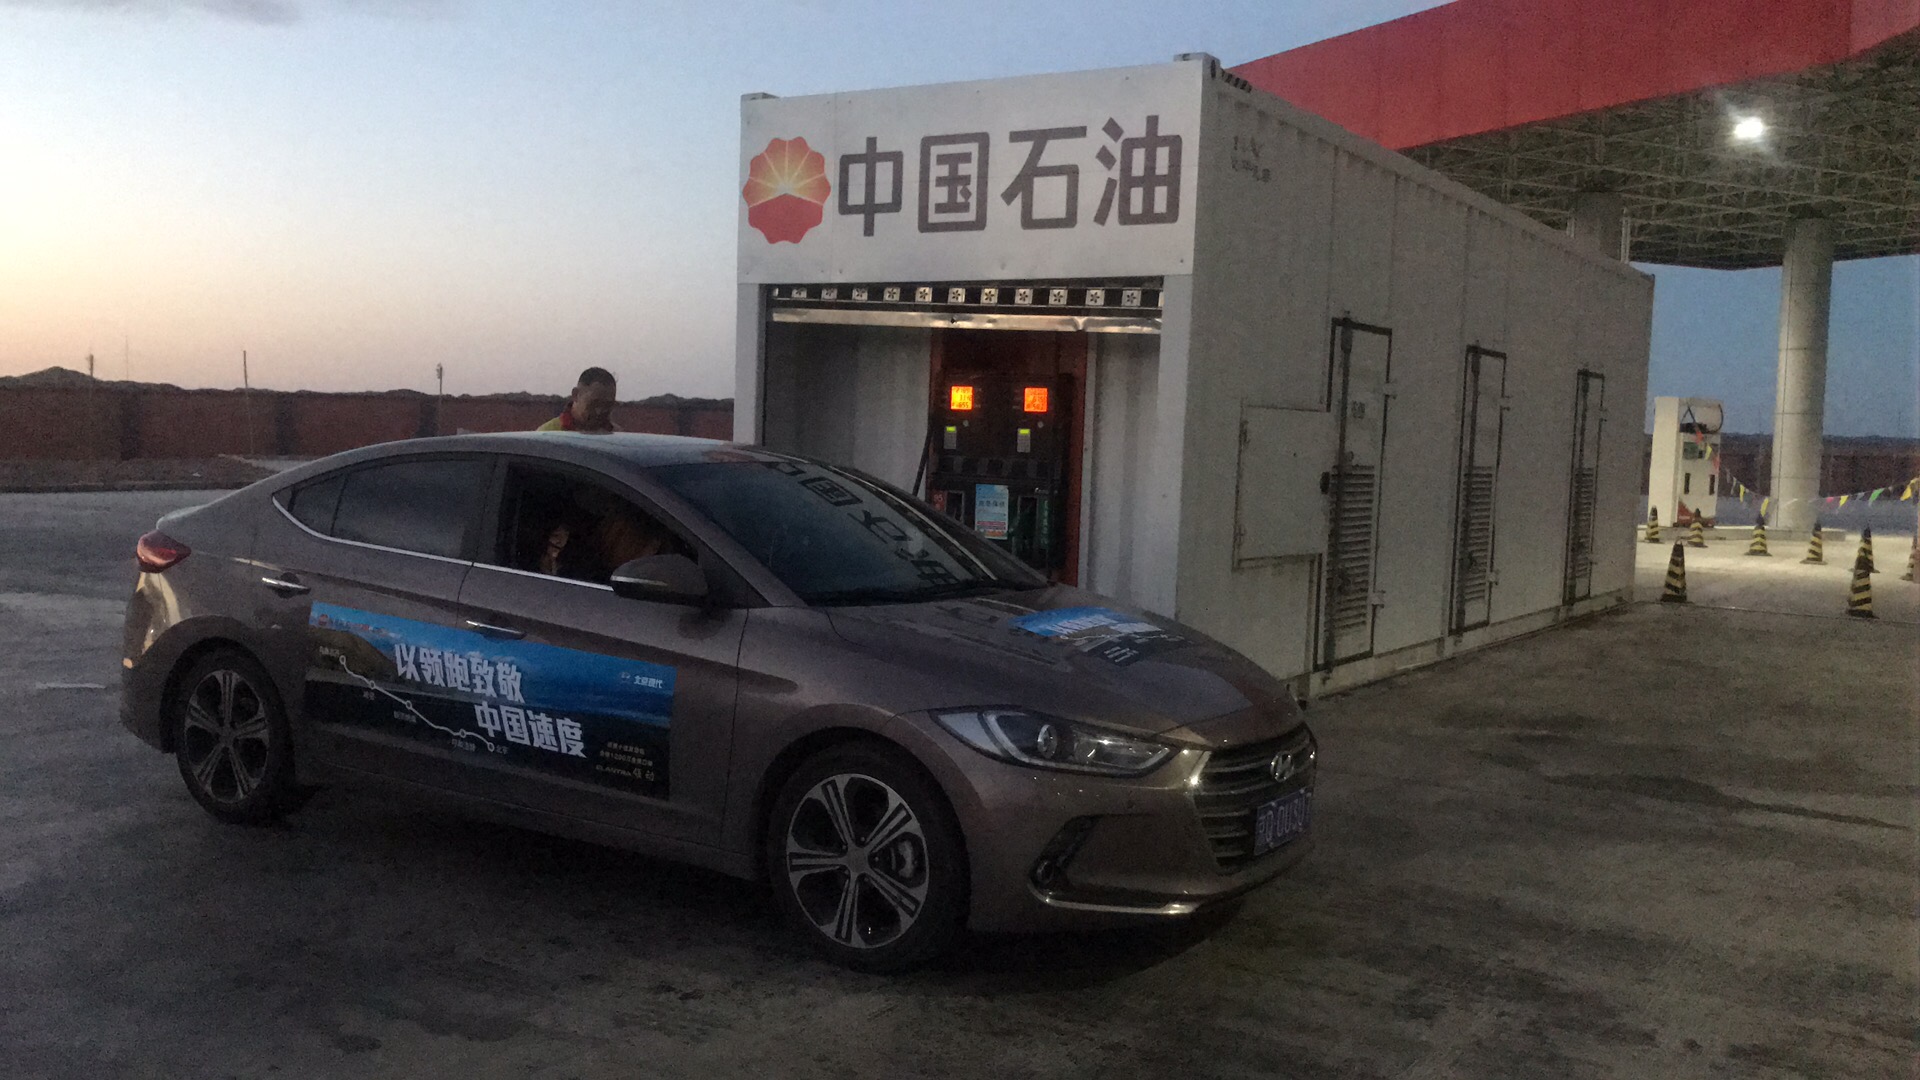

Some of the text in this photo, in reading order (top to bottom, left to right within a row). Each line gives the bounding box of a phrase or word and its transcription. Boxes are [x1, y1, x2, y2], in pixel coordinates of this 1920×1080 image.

[838, 115, 1183, 237] 中国石油
[395, 643, 525, 704] 以领跑致敬
[474, 700, 588, 759] 中国速度
